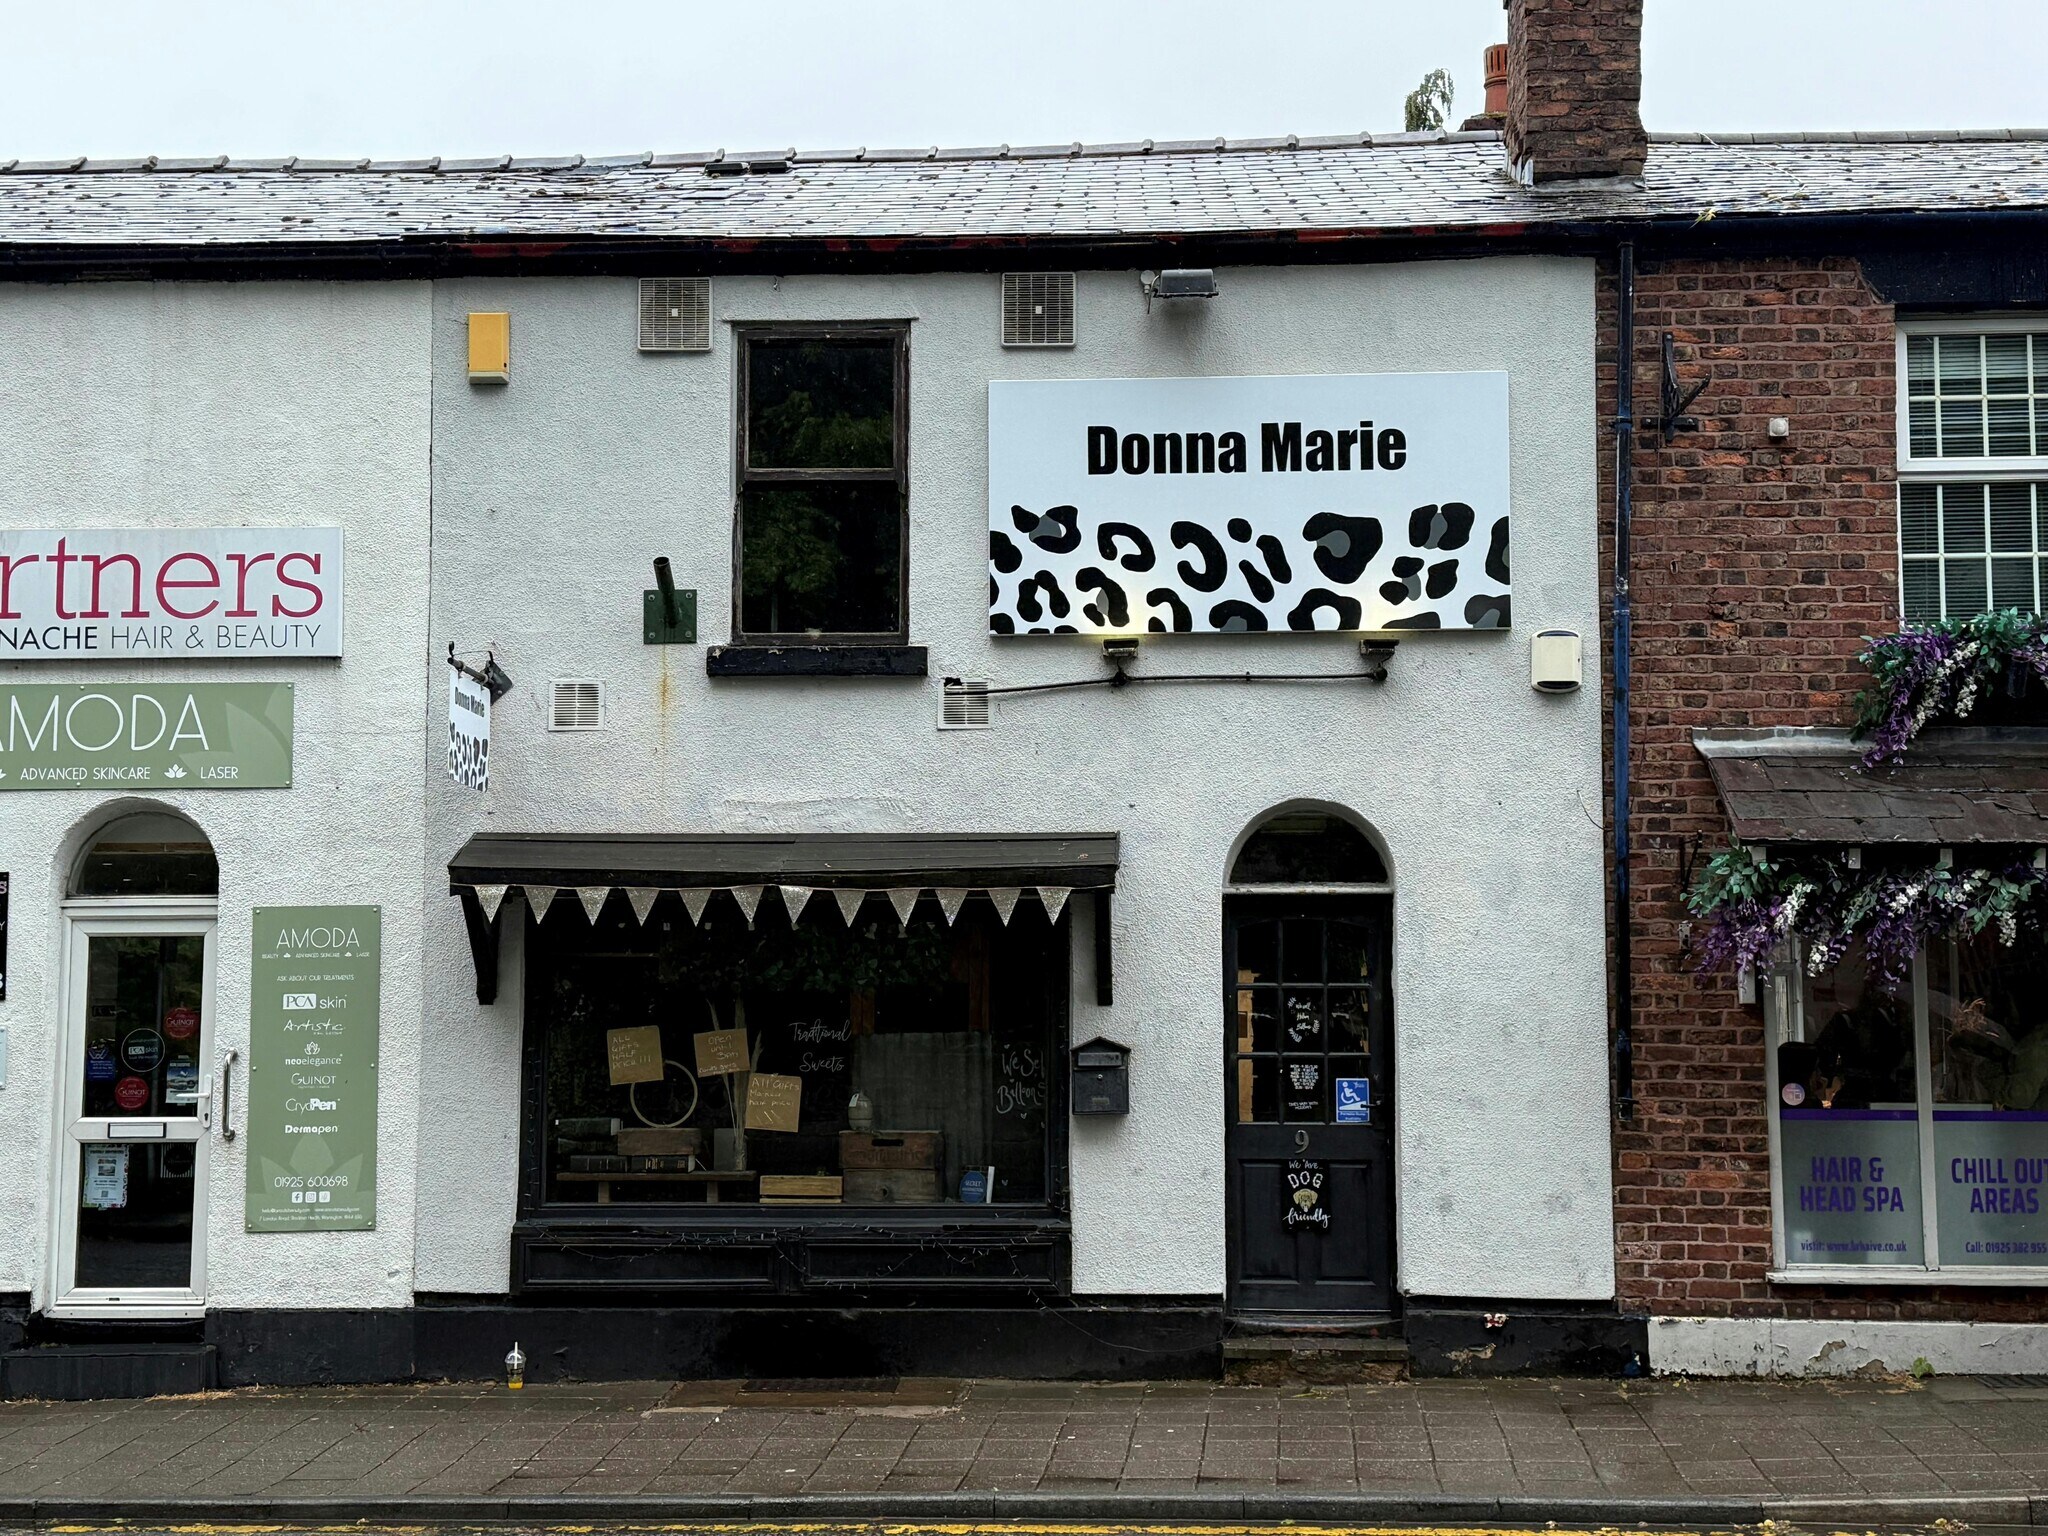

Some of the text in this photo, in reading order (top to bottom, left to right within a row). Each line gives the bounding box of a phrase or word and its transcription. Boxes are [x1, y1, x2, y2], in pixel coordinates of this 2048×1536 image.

[1086, 420, 1408, 476] Donna Marie
[111, 625, 174, 649] HAIR
[184, 625, 205, 649] &
[216, 624, 322, 648] BEAUTY
[454, 686, 486, 718] Donna Marie
[0, 693, 210, 752] MODA
[20, 766, 239, 781] ADVANCED SKINCARE LASER
[276, 927, 360, 949] AMODA
[286, 995, 347, 1009] PCA skin
[283, 1018, 345, 1032] Artistic
[786, 1018, 853, 1044] Traditional
[612, 1035, 631, 1044] ALL
[285, 1056, 342, 1067] neoelegance
[798, 1051, 847, 1073] Sweets
[1001, 1050, 1020, 1077] We
[290, 1072, 337, 1086] GUINOT
[751, 1077, 769, 1088] All
[285, 1097, 337, 1115] CryoPen
[284, 1124, 338, 1136] Dermapen
[1294, 1129, 1310, 1154] 9
[1287, 1170, 1324, 1189] DOG
[1811, 1156, 1884, 1183] HAIR &
[1951, 1157, 2009, 1184] CHILL
[274, 1175, 349, 1188] 01925 600698
[1799, 1185, 1905, 1213] HEAD SPA
[1970, 1187, 2040, 1214] AREAS
[1282, 1207, 1332, 1229] friendly
[1965, 1241, 1984, 1253] Call:
[1985, 1242, 2011, 1254] 01925
